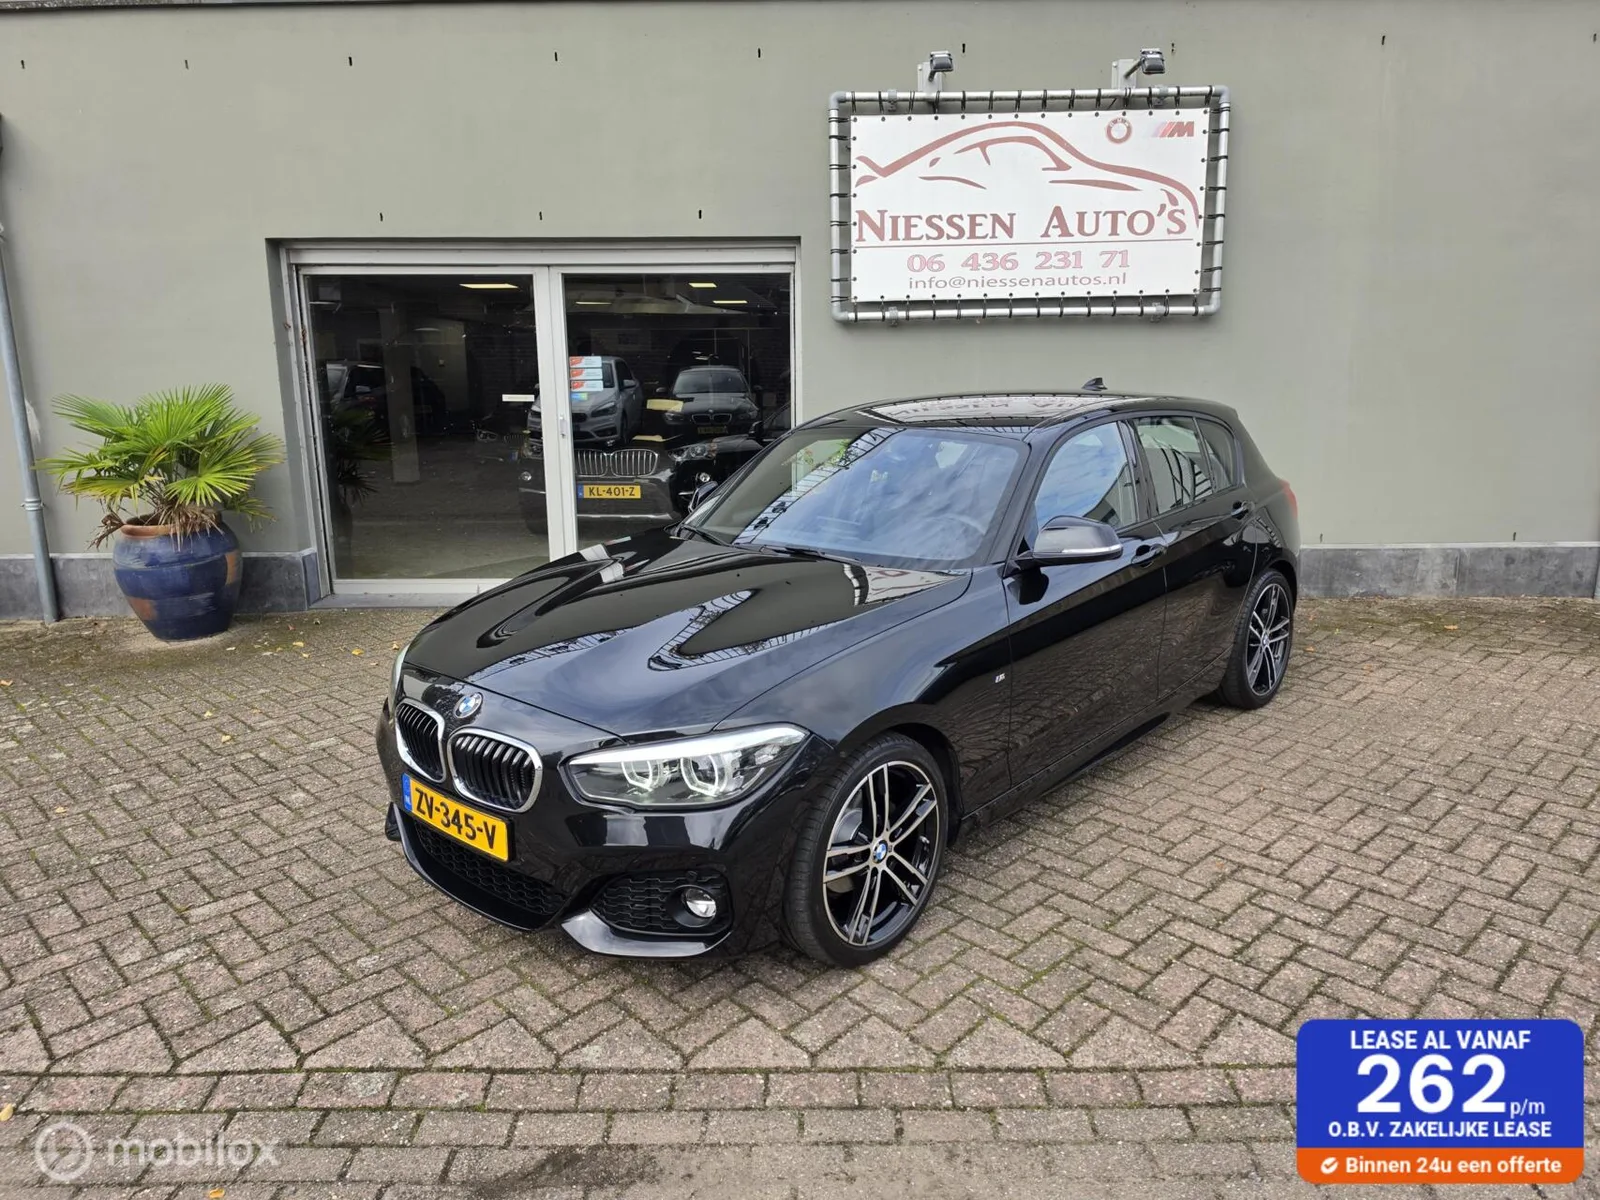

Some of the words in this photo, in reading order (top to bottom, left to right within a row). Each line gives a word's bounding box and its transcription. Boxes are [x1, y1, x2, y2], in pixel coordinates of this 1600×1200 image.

[855, 209, 1017, 242] NIESSEN
[906, 253, 946, 273] 06
[960, 252, 1019, 271] 436
[1034, 250, 1083, 270] 231
[1099, 249, 1130, 268] 71
[909, 272, 1127, 289] info@niessenautos.nl
[588, 486, 636, 497] KL-401-Z
[415, 787, 496, 850] ZV-345-V
